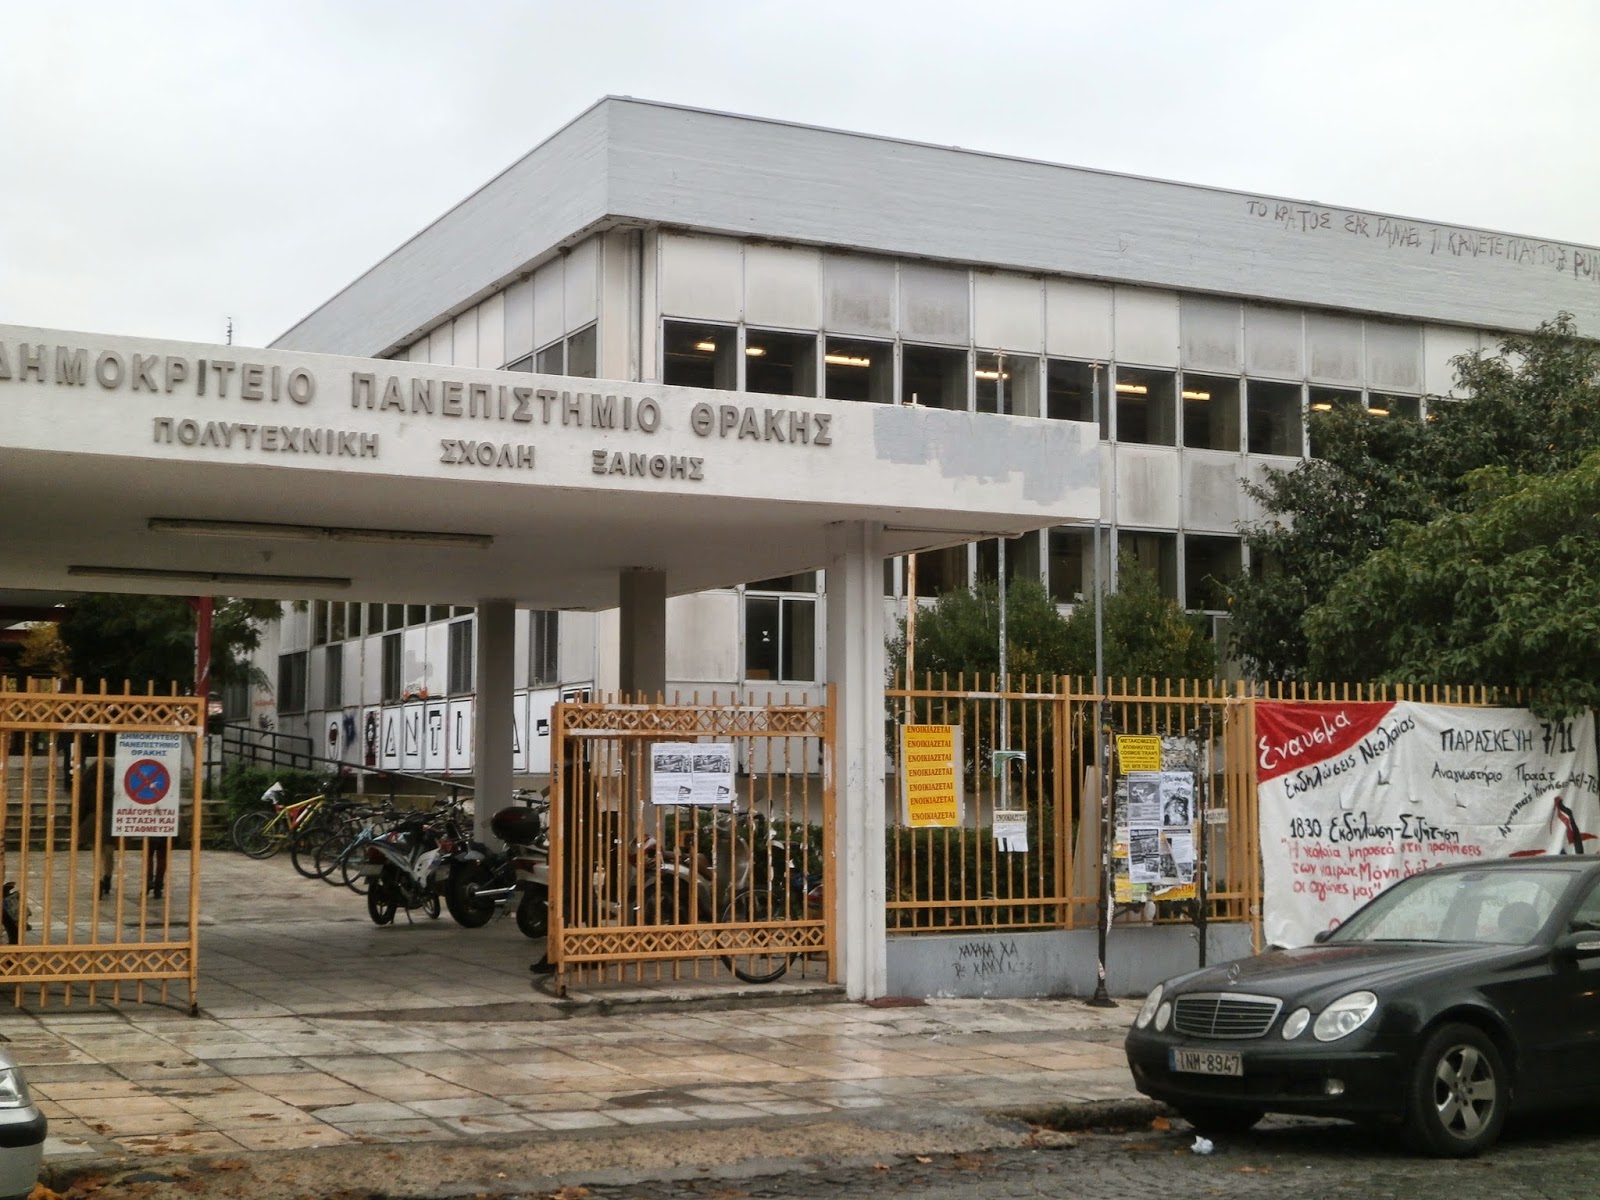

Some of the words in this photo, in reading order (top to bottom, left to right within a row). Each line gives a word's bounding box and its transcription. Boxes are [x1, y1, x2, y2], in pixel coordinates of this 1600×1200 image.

[351, 371, 661, 434] ΠΑΝΕΠΙΣΤΗΜΙΟ
[691, 401, 833, 446] ΘΡΑΚΗΣ
[153, 416, 381, 458] ΠΟΛΥΤΕΧΝΙΚΗ
[440, 438, 536, 470] ΣΧΟΛΗ
[592, 448, 705, 481] ΞΑΝΘΗΣ
[119, 741, 179, 749] ΠΑΝΕΠΙΣΤΗΜΙΟ
[1440, 728, 1533, 753] ΠΑΡΑΣΚΕΥΗ
[1540, 721, 1576, 757] 7/11
[116, 808, 175, 816] ΑΠΑΓΟΡΕΥΕΤΑΙ
